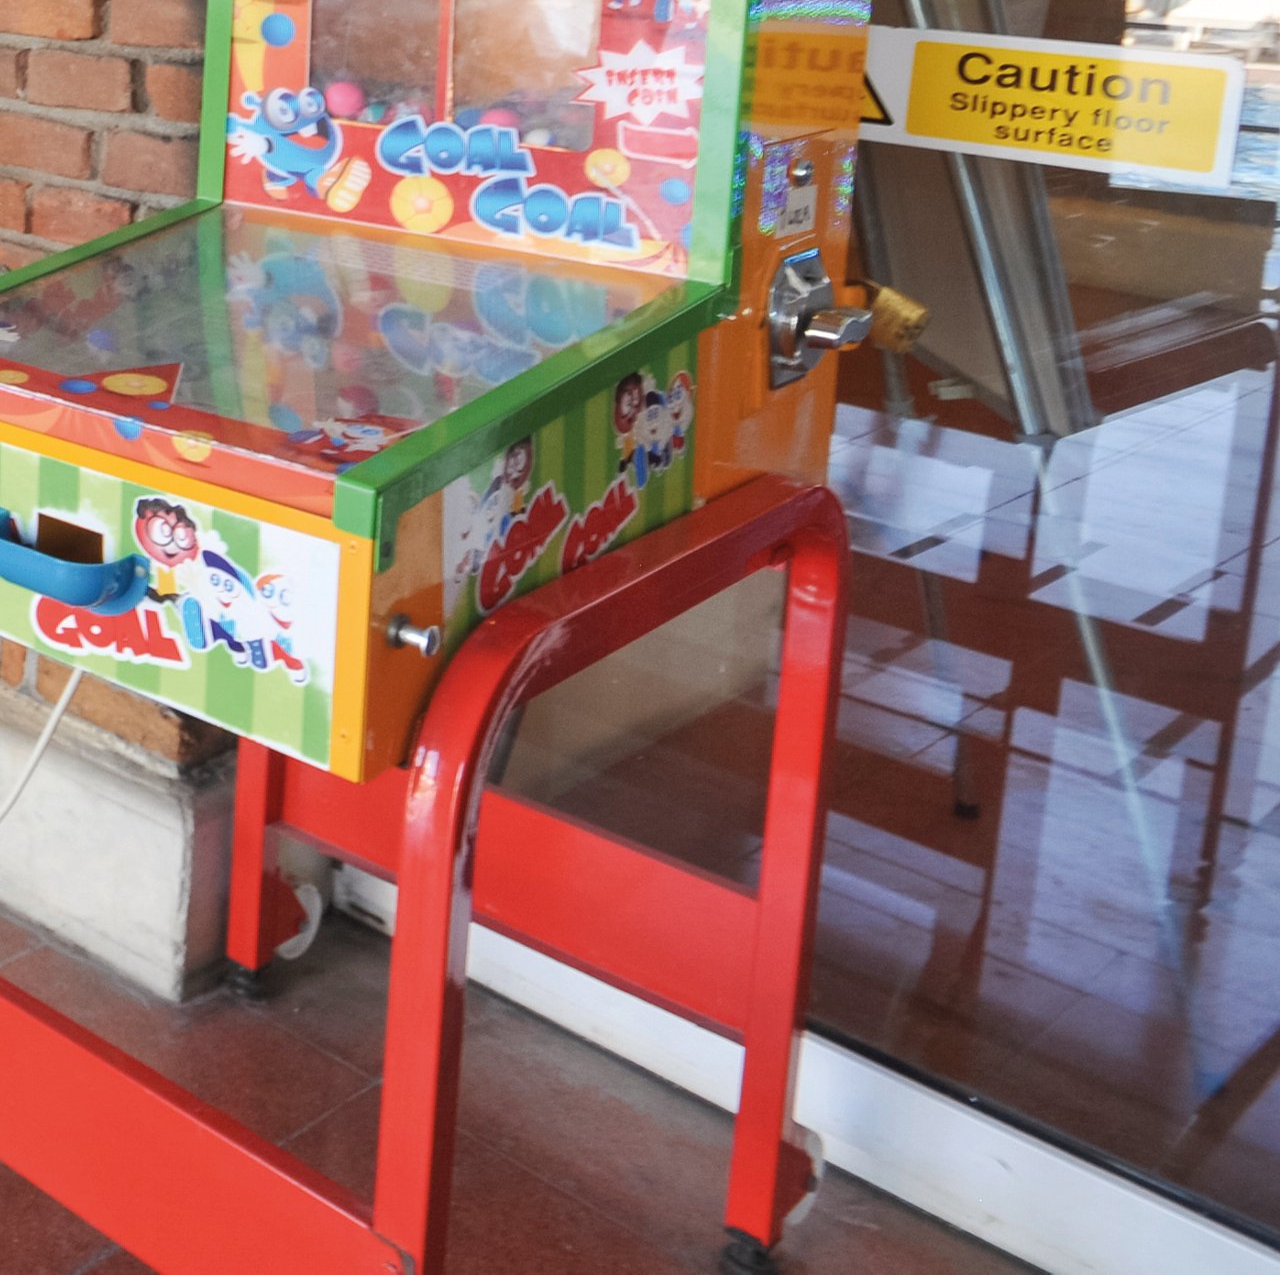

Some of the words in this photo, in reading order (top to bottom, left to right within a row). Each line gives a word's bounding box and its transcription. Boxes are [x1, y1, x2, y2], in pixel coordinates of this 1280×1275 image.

[956, 52, 1171, 106] Caution
[950, 92, 1080, 128] Slippery
[1091, 107, 1171, 135] floor
[994, 124, 1115, 153] surface
[376, 115, 536, 177] GOAL
[470, 174, 639, 251] GOAL
